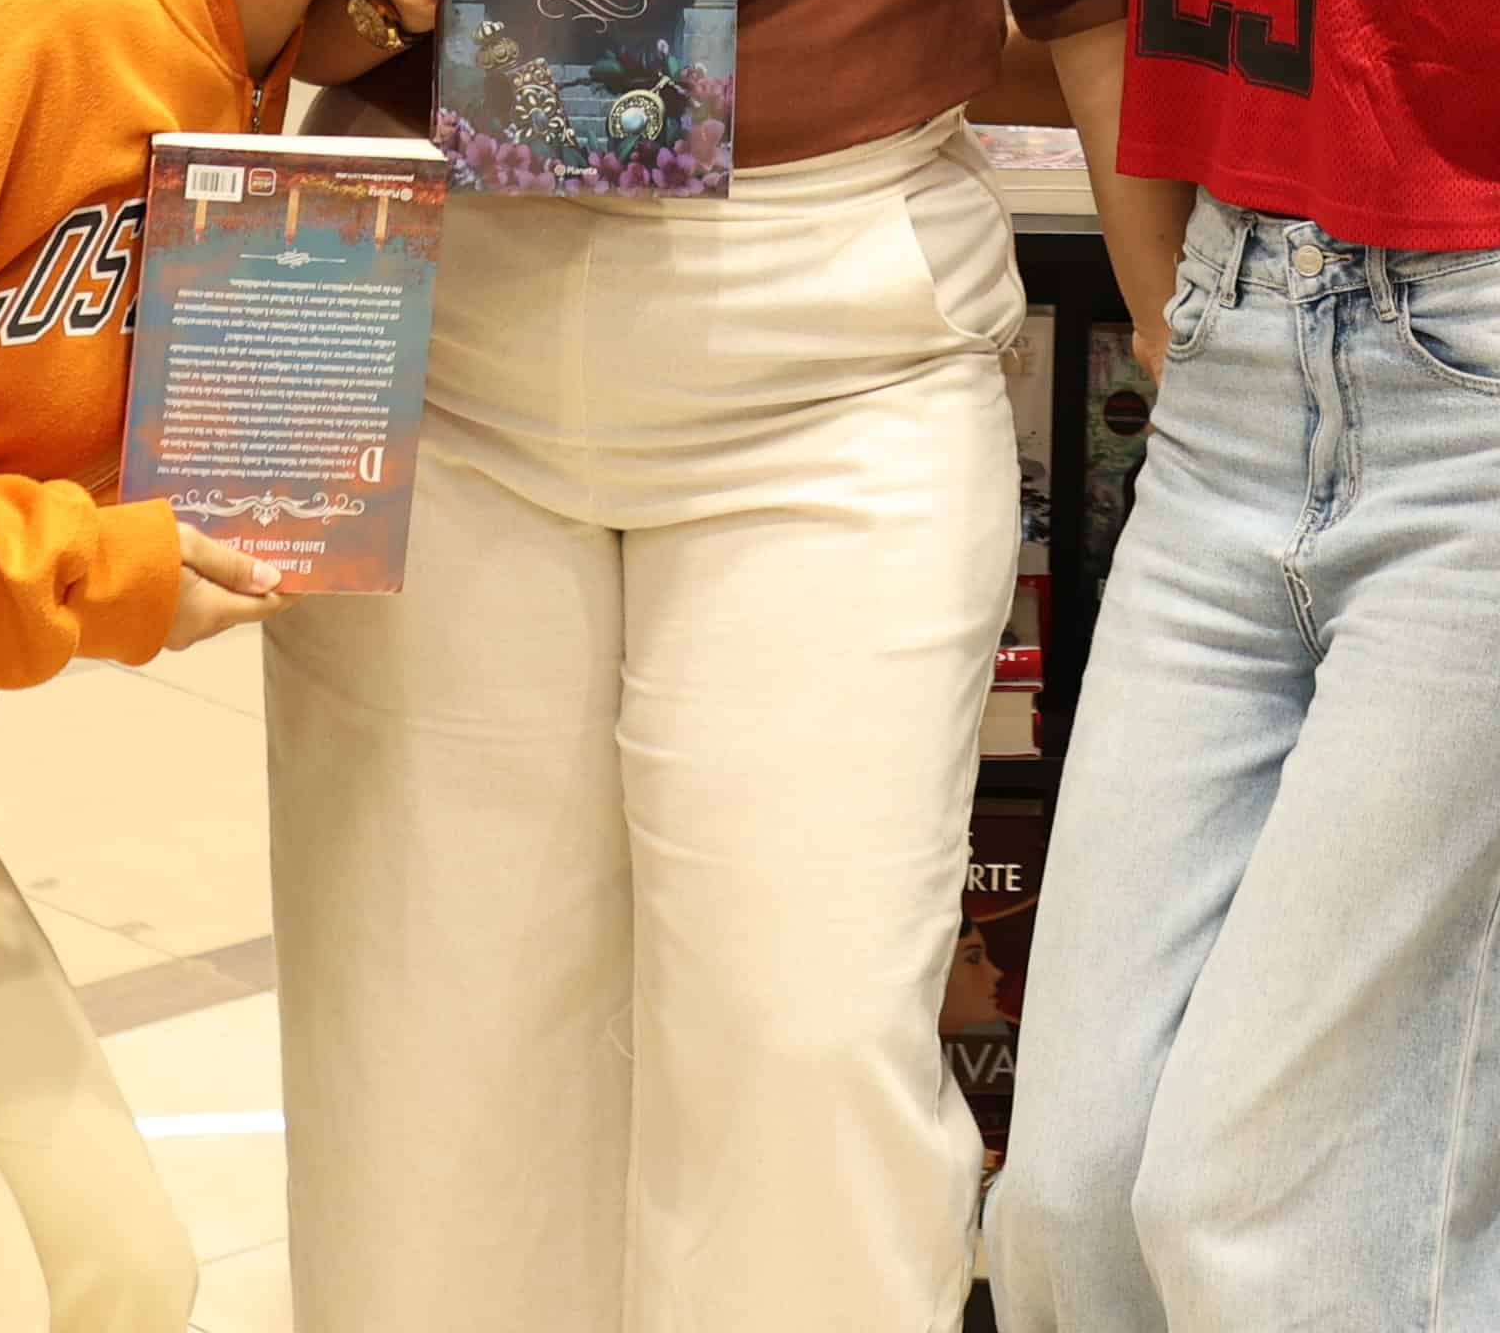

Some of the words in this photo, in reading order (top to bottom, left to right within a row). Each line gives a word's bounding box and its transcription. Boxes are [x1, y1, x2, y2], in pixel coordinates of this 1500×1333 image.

[242, 539, 254, 554] la
[256, 540, 291, 552] como
[291, 540, 326, 554] tanto
[300, 559, 312, 574] El
